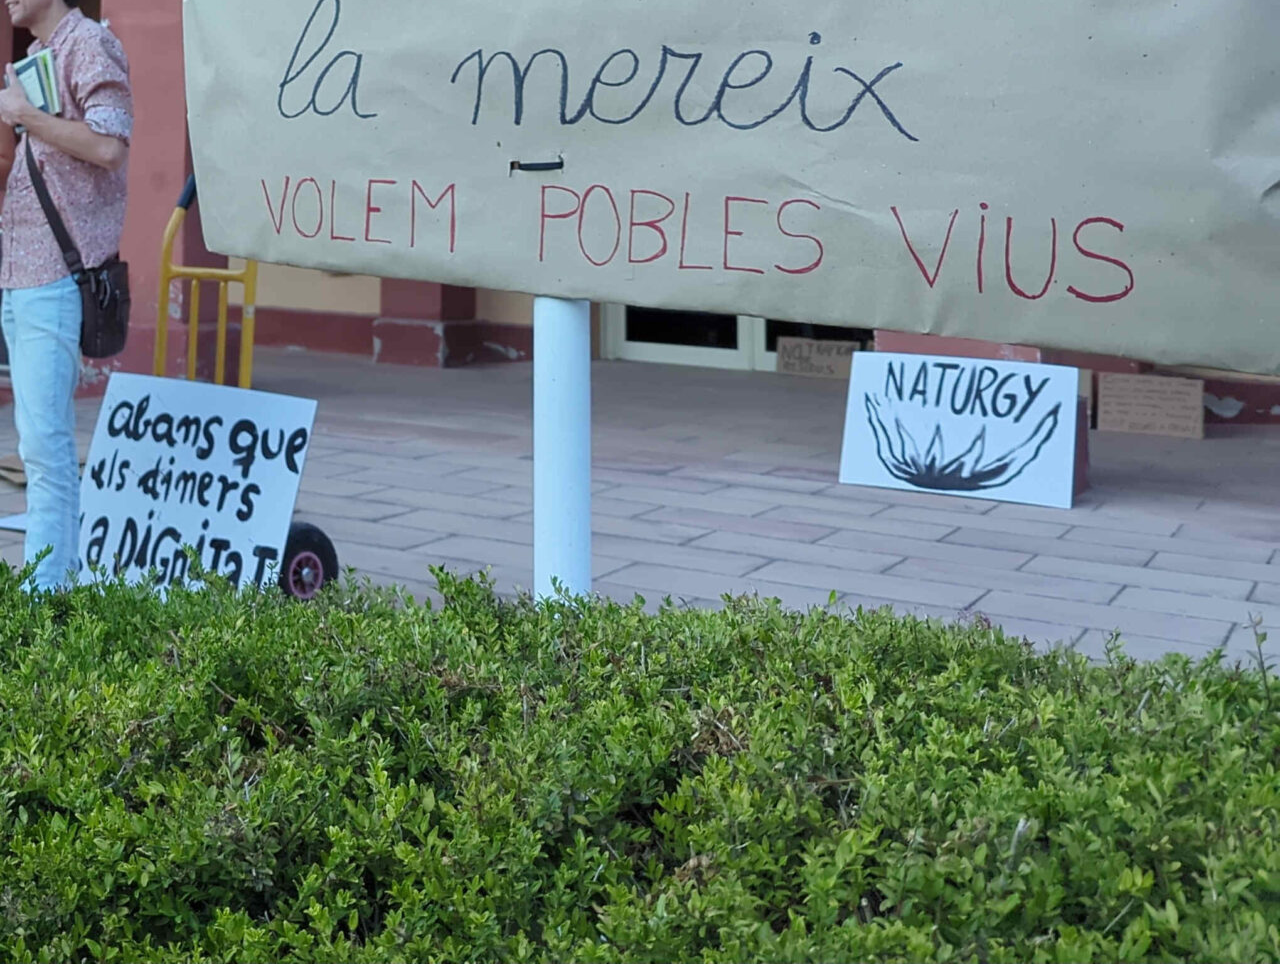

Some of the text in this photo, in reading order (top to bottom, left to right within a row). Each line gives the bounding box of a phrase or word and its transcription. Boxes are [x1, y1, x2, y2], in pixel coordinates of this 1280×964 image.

[451, 32, 920, 143] mereix
[261, 177, 458, 255] VOLEM
[538, 183, 826, 276] POBLES
[108, 393, 308, 479] abans que
[885, 361, 1050, 424] NATURGY
